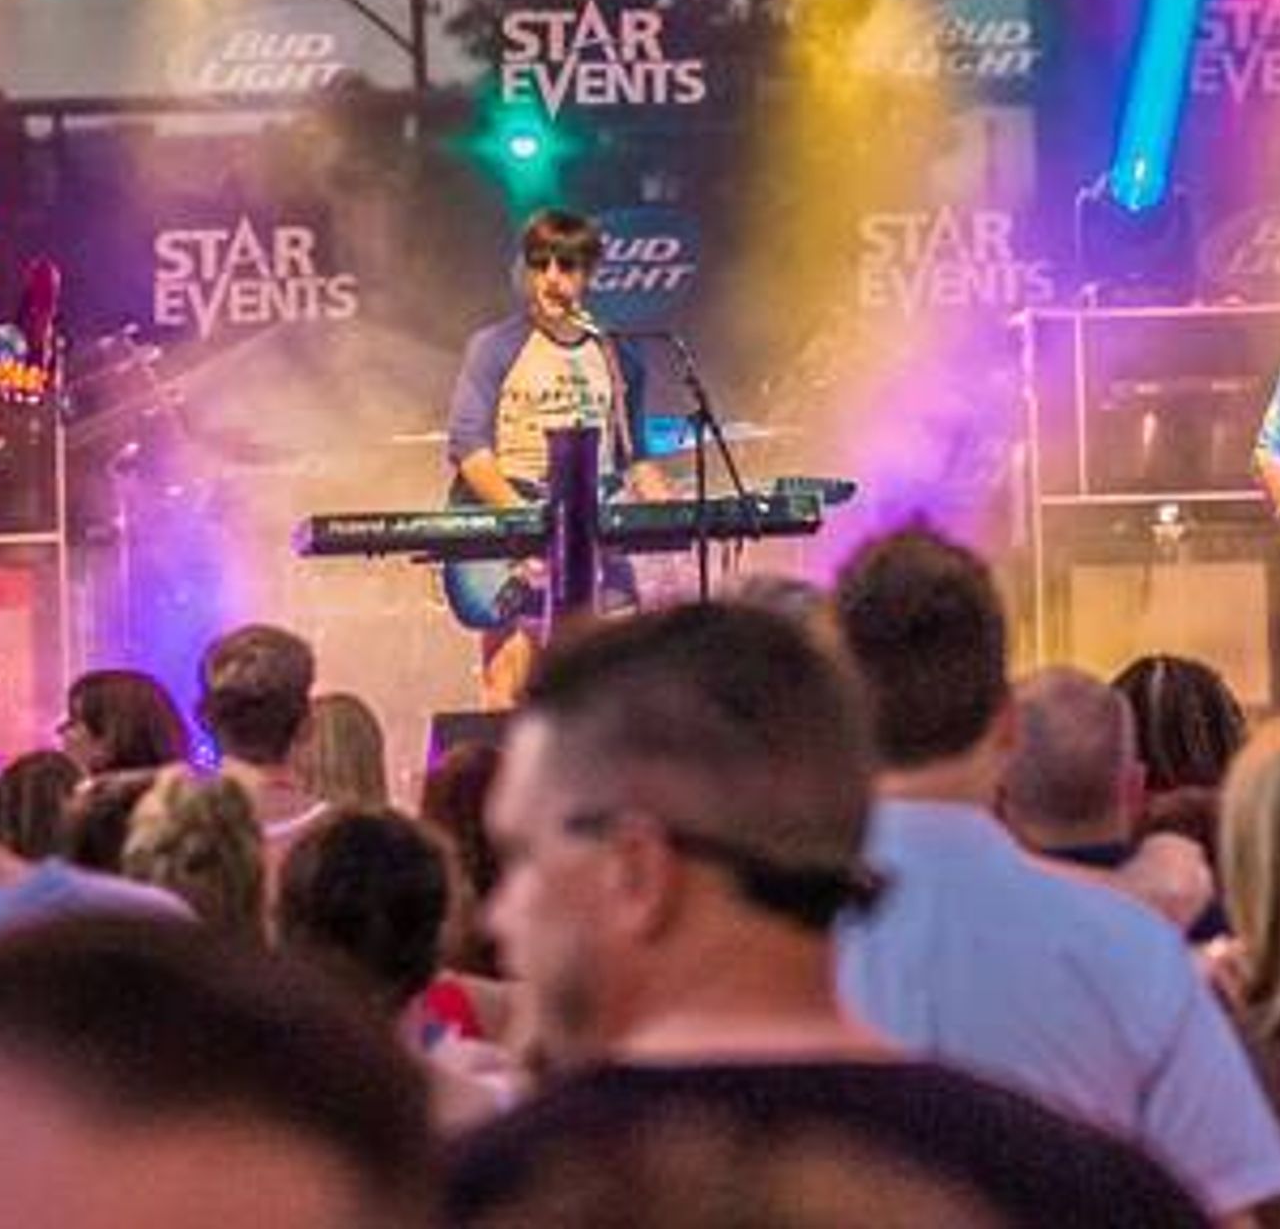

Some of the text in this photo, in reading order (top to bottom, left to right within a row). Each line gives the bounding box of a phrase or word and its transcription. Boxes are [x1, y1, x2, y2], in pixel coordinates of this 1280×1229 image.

[221, 29, 337, 62] BUD
[199, 62, 345, 92] LIGHT
[501, 59, 707, 121] EVENTS
[153, 216, 316, 279] STAR
[601, 232, 681, 262] UD
[857, 205, 1014, 263] STAR
[153, 274, 359, 340] EVENTS
[589, 264, 696, 292] GHT
[859, 261, 1056, 319] EVENTS
